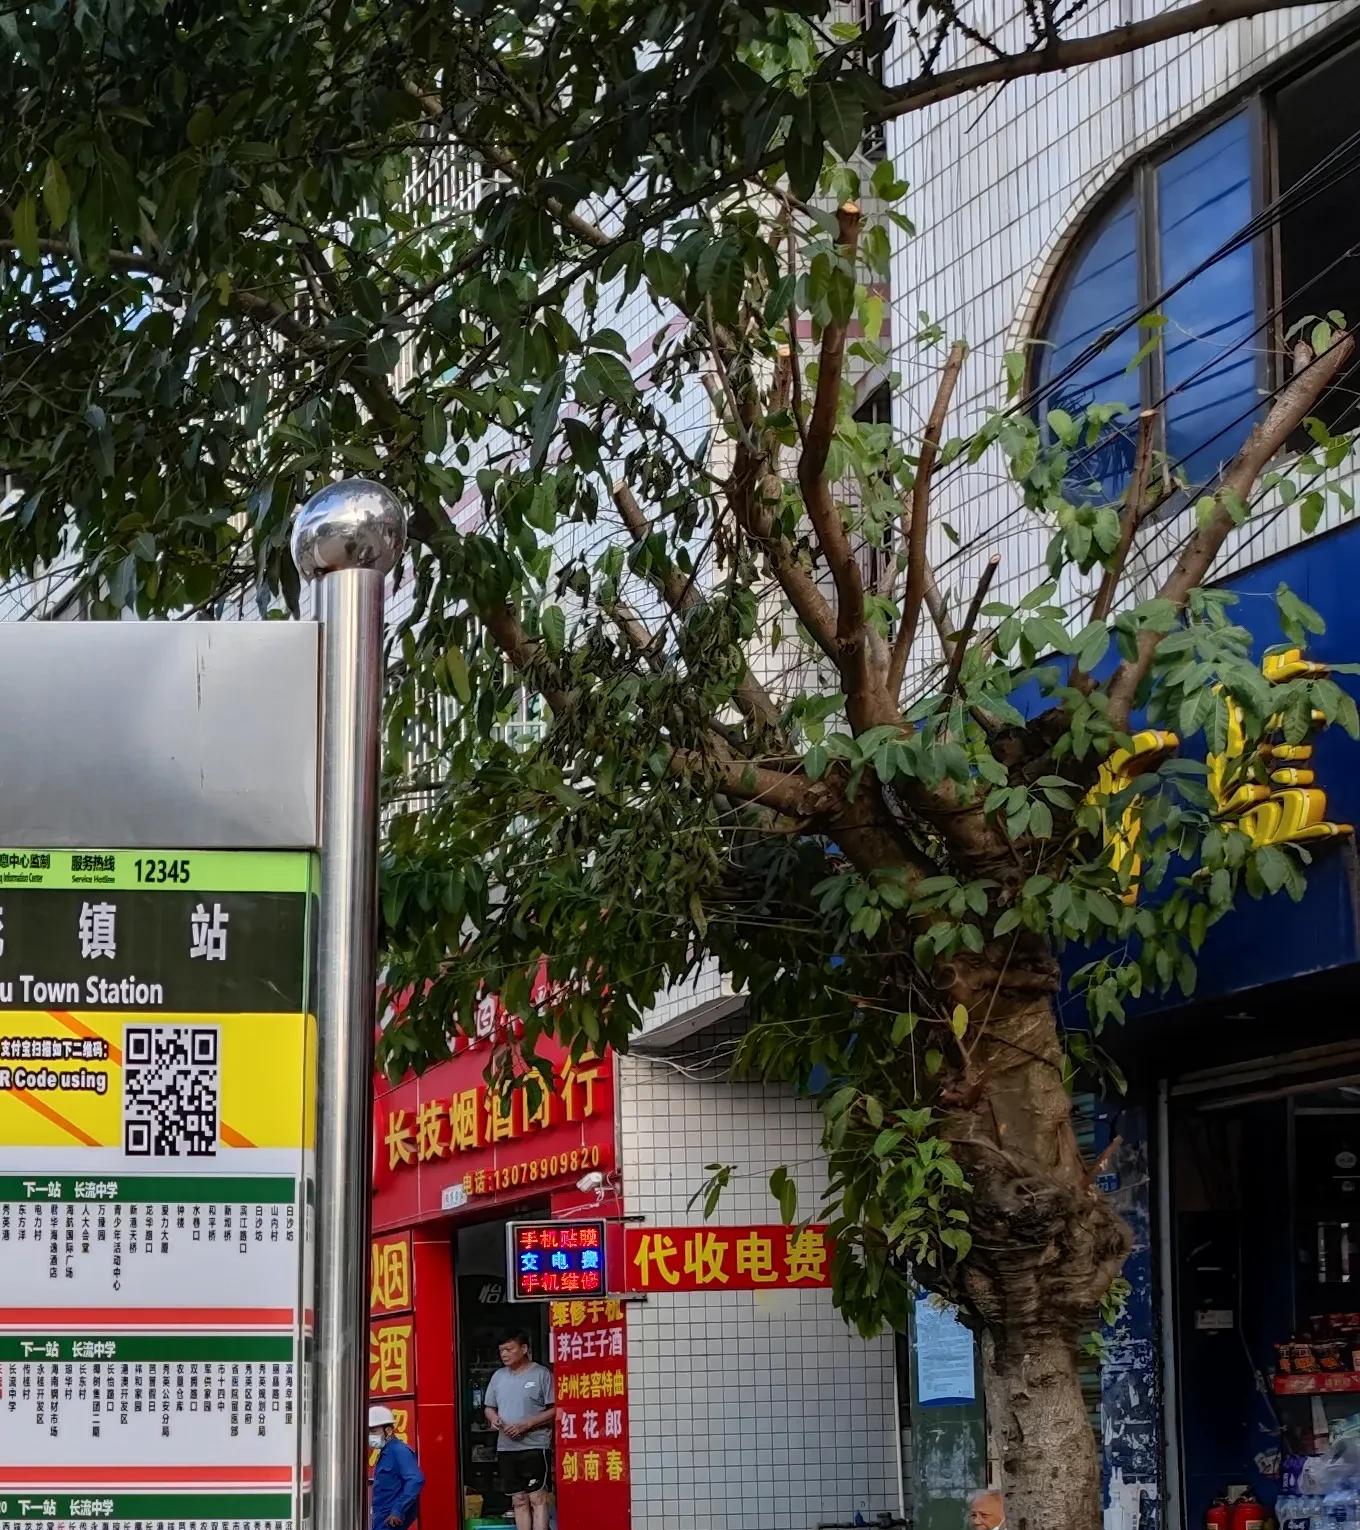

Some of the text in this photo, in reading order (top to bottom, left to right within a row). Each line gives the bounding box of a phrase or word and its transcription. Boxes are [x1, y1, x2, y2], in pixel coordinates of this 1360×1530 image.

[72, 855, 115, 871] 服务热线
[134, 859, 190, 883] 12345
[72, 875, 92, 883] Service
[21, 976, 79, 1004] Town
[86, 976, 163, 1005] Station
[15, 1070, 57, 1088] Code
[61, 1071, 106, 1092] using
[23, 1182, 118, 1198] 下一站 长流中学
[520, 1228, 598, 1249] 手机贴膜
[521, 1250, 599, 1271] 交电费
[634, 1231, 829, 1286] 代收电费
[521, 1271, 599, 1293] 手机维修
[21, 1341, 115, 1358] 下一站 长流中学
[558, 1327, 623, 1363] 茅台王子酒
[370, 1325, 412, 1392] 酒
[558, 1368, 624, 1400] 泸州老窖特曲
[561, 1409, 622, 1439] 红花郎
[562, 1450, 623, 1481] 剑南春
[18, 1499, 113, 1516] 下一站 长流中学
